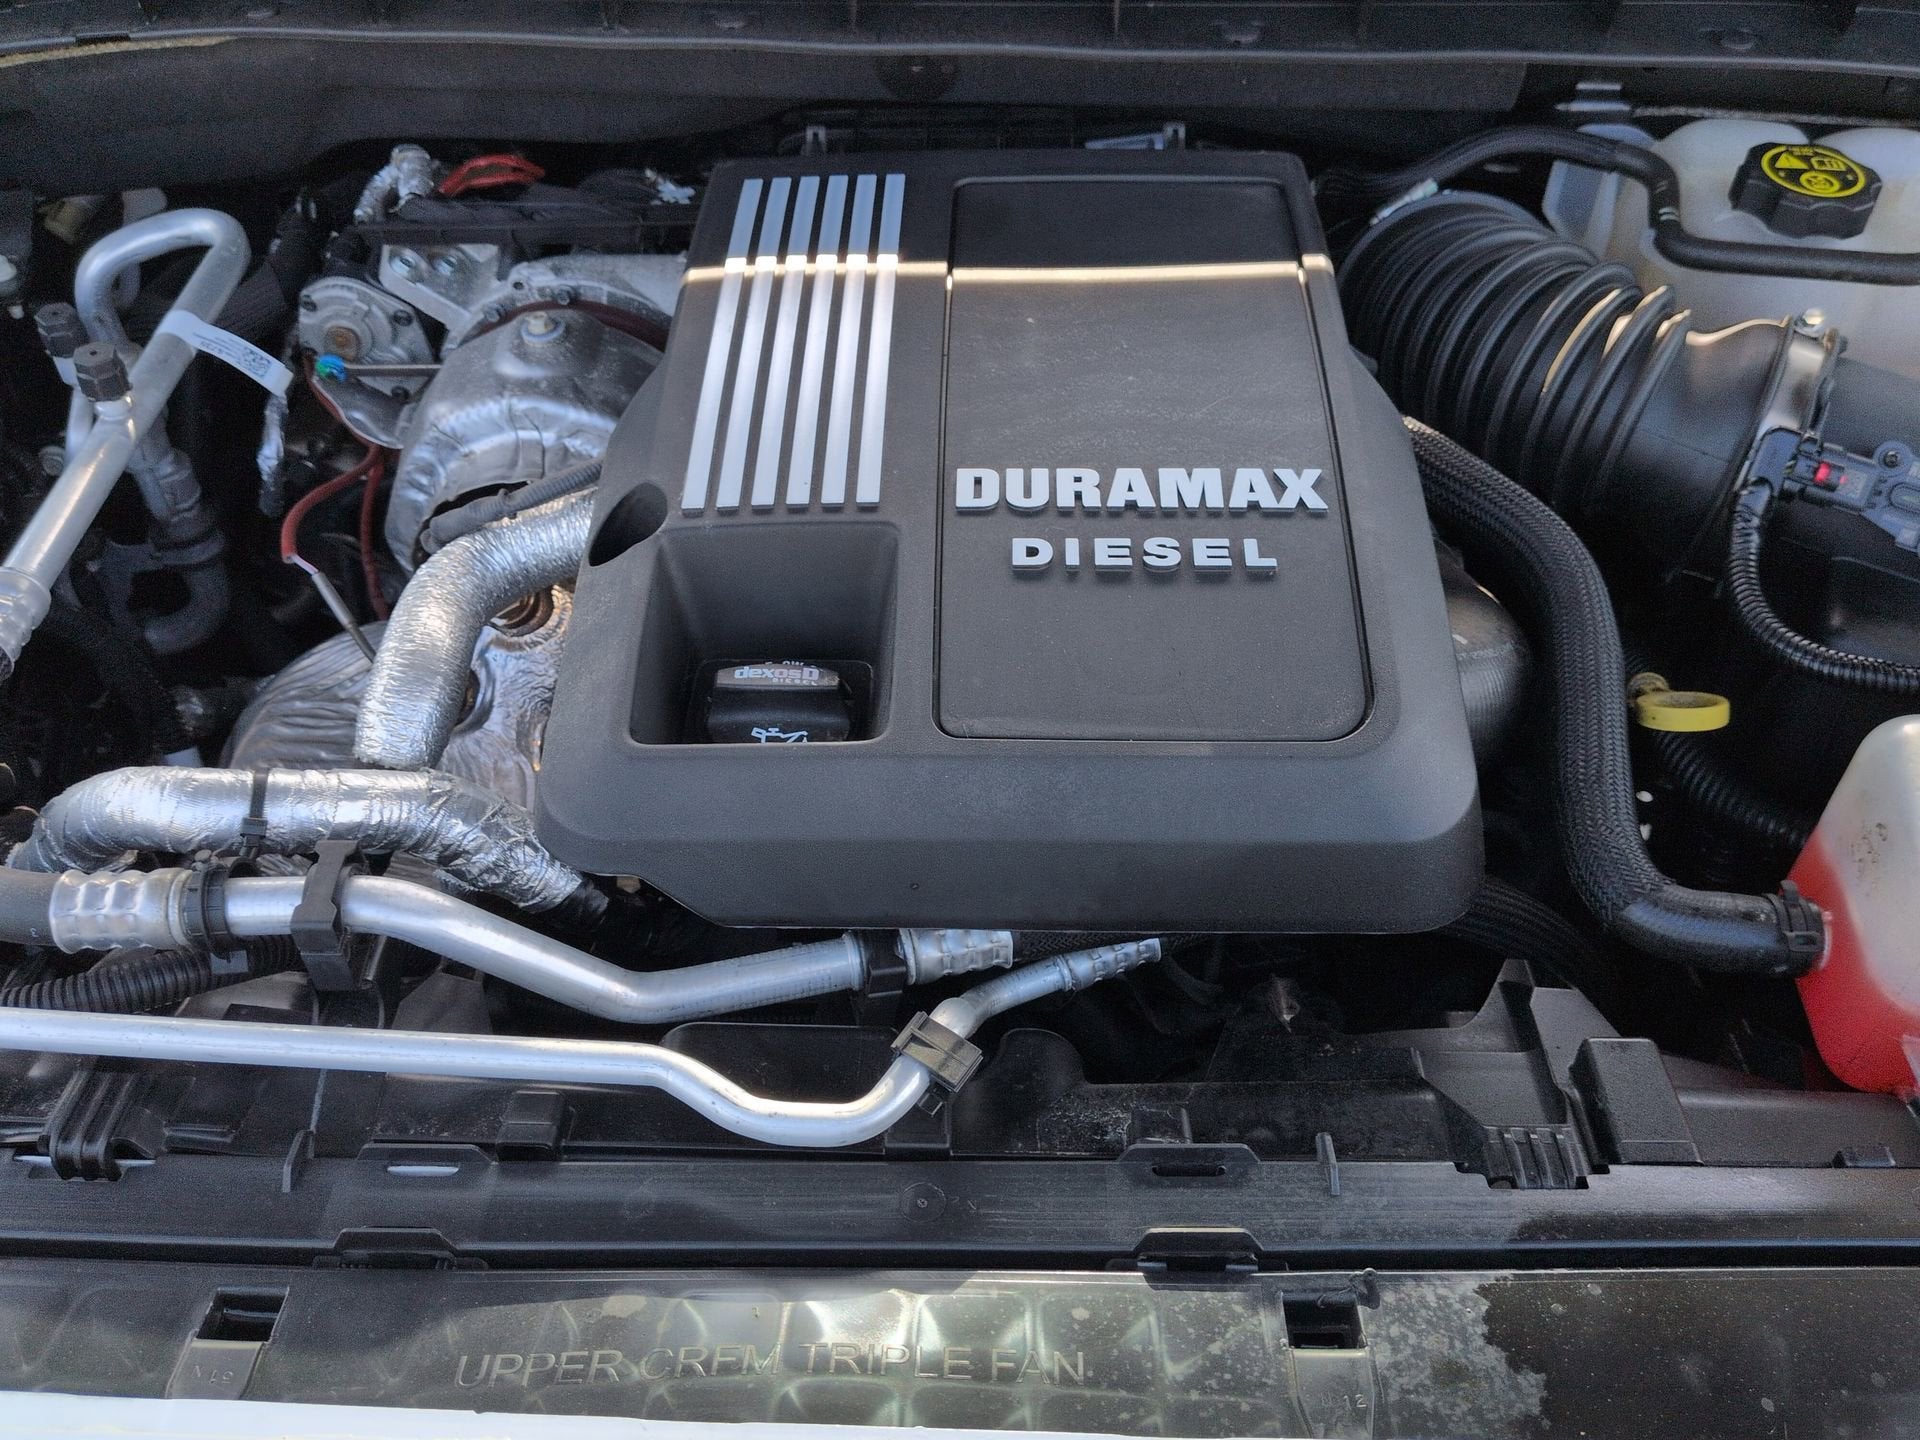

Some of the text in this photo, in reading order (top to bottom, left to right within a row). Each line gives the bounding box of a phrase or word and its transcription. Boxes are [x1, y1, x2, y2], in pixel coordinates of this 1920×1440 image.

[955, 467, 1329, 512] DURAMAX
[1011, 537, 1279, 571] DIESEL
[453, 1342, 1085, 1388] UPPER CRFM TRIPLE FAN
